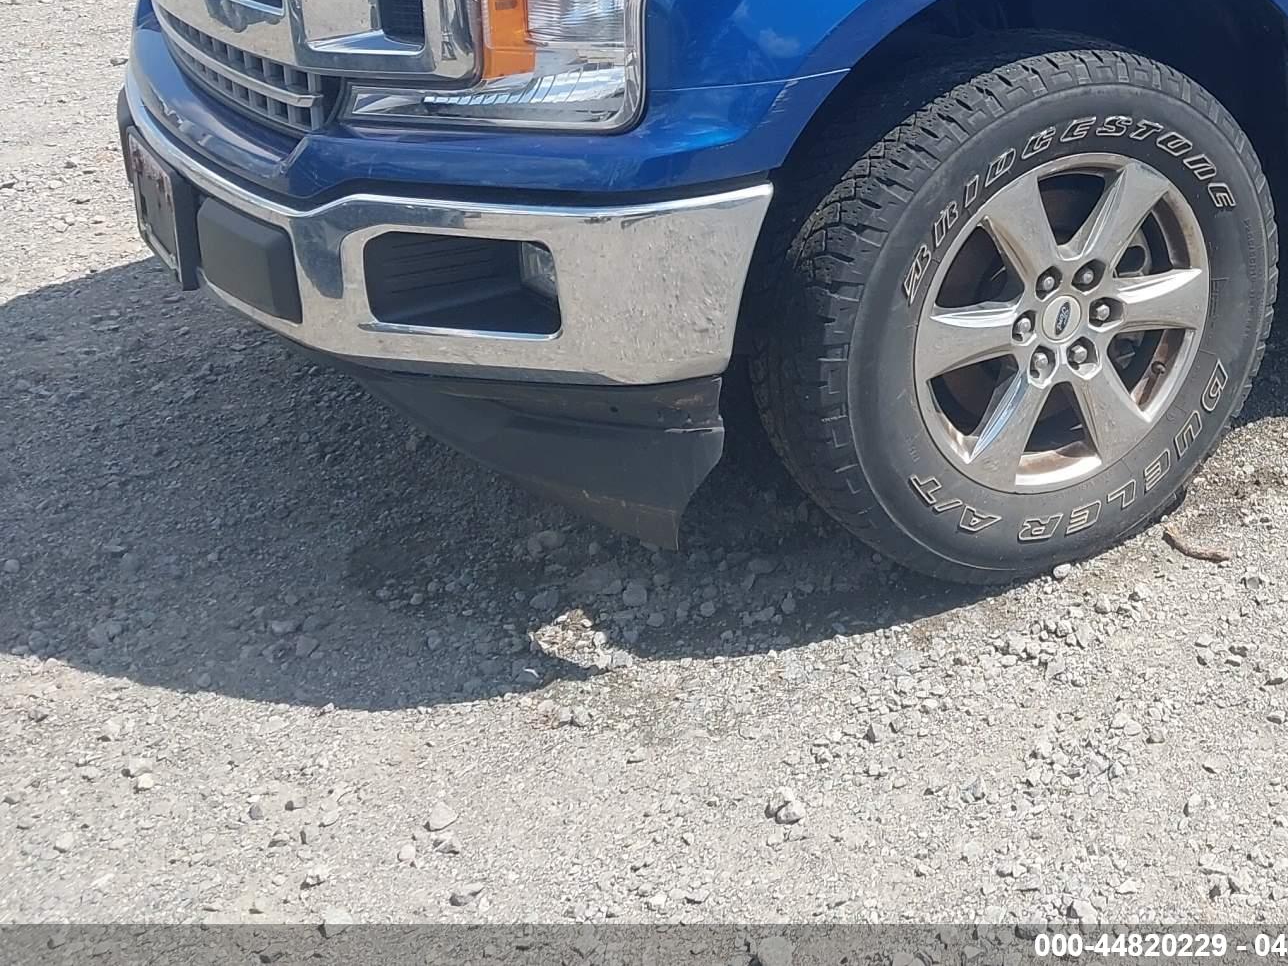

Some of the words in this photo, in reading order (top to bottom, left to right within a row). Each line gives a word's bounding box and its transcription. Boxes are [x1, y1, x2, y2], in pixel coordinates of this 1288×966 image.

[903, 115, 1238, 306] BRIDGESTONE
[909, 473, 1002, 532] A/T
[1018, 359, 1229, 541] DUELER
